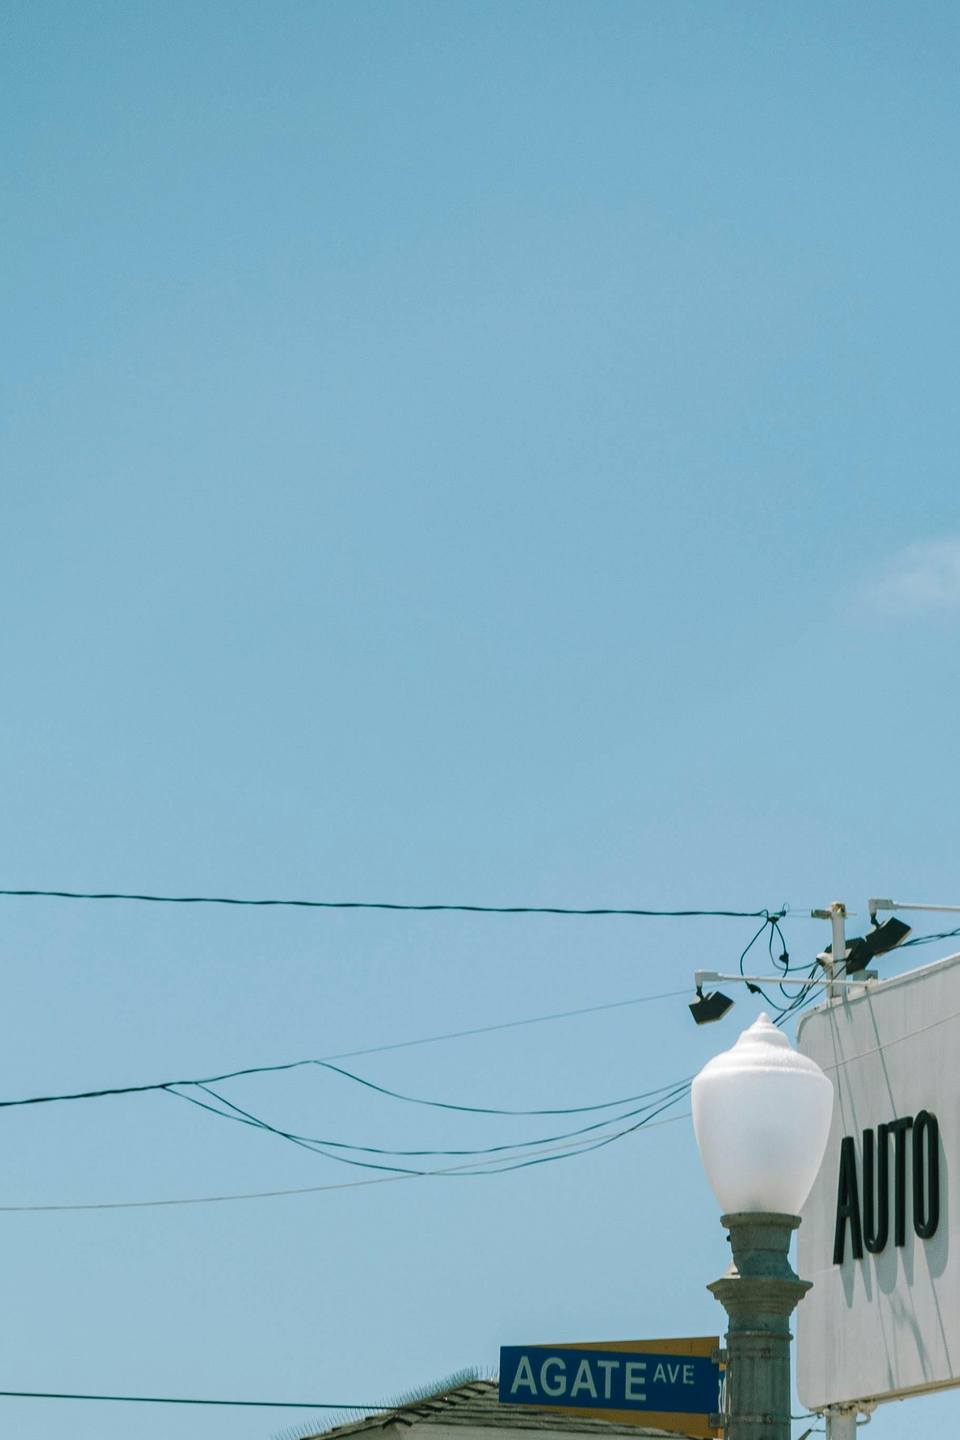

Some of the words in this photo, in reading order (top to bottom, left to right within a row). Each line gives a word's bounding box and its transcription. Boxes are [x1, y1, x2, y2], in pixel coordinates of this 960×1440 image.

[833, 1109, 940, 1265] AUTO
[510, 1355, 647, 1401] AGATE
[653, 1363, 695, 1385] AVE
